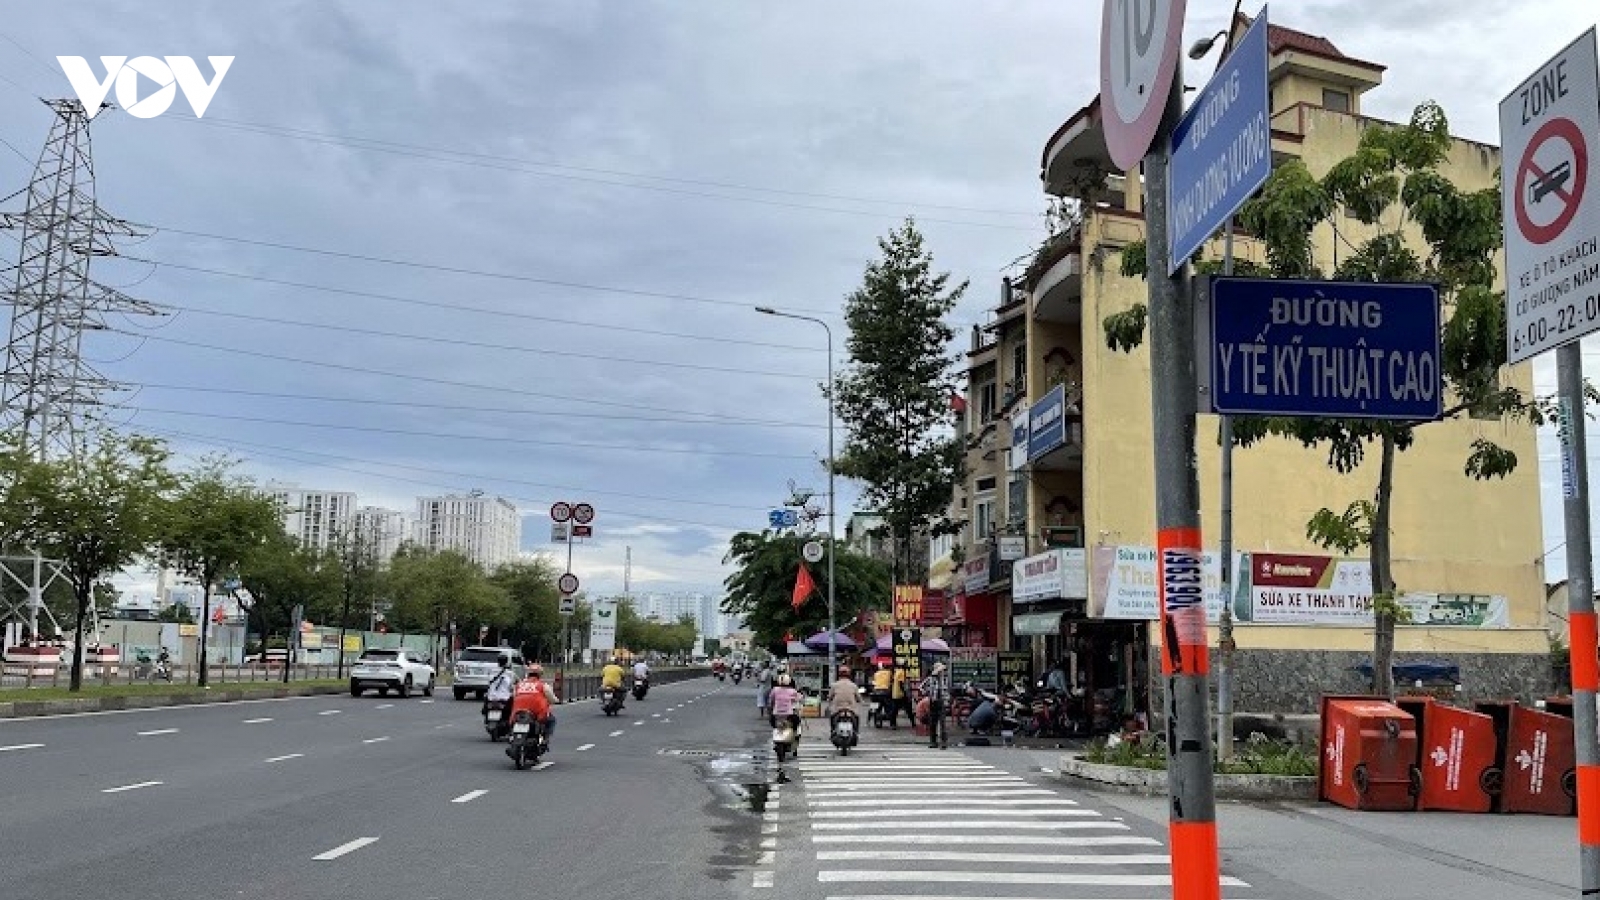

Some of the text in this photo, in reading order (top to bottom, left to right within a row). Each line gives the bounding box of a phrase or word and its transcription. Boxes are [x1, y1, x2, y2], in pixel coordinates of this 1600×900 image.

[1191, 69, 1240, 150] ĐƯỜNG
[1520, 59, 1569, 126] ZONE
[1519, 272, 1531, 290] XE
[1560, 235, 1597, 270] KHÁCH
[1268, 289, 1383, 329] ĐƯỜNG
[1219, 323, 1434, 410] Y TẾ KỸ THUẬT CAO
[1260, 587, 1284, 607] SỬA
[1288, 592, 1302, 607] XE
[1306, 593, 1345, 609] THANH
